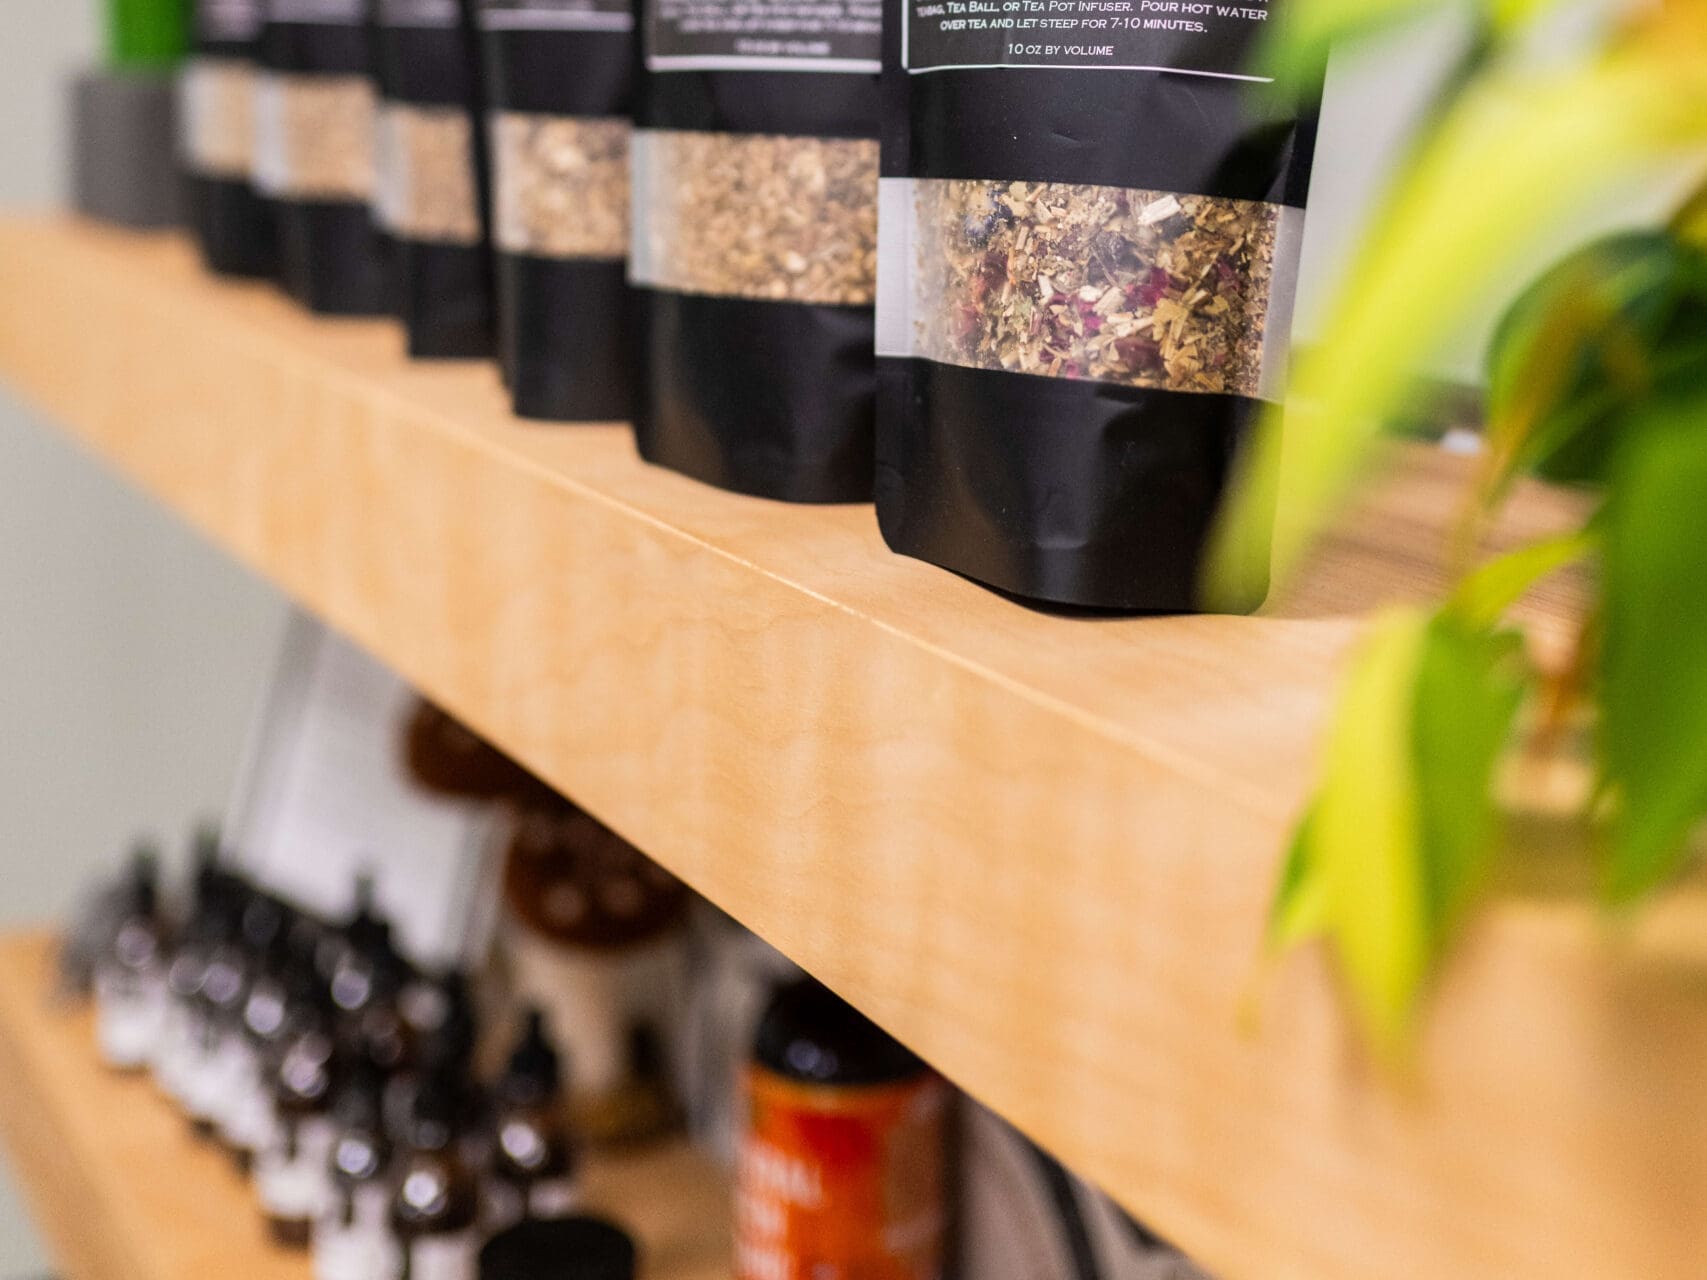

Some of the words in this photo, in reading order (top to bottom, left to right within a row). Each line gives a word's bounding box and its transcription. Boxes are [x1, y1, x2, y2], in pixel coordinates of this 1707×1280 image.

[946, 2, 966, 13] TEA
[1002, 1, 1020, 12] OR
[1022, 0, 1045, 11] TEA
[1048, 0, 1075, 12] POT
[1078, 0, 1134, 12] INFUSER.
[1140, 0, 1178, 12] POUR
[1181, 2, 1213, 15] HOT
[1216, 6, 1268, 20] WATER
[940, 19, 966, 31] OVER
[967, 18, 987, 30] TEA
[989, 18, 1014, 29] AND
[1016, 18, 1038, 29] LET
[1039, 18, 1079, 29] STEEP
[1081, 18, 1107, 29] FOR
[1110, 17, 1141, 29] 7-10
[1143, 18, 1208, 33] MINUTES.
[1007, 43, 1024, 55] 10
[1025, 45, 1041, 55] OZ
[1045, 45, 1060, 55] BY
[1063, 45, 1114, 56] VOLUME
